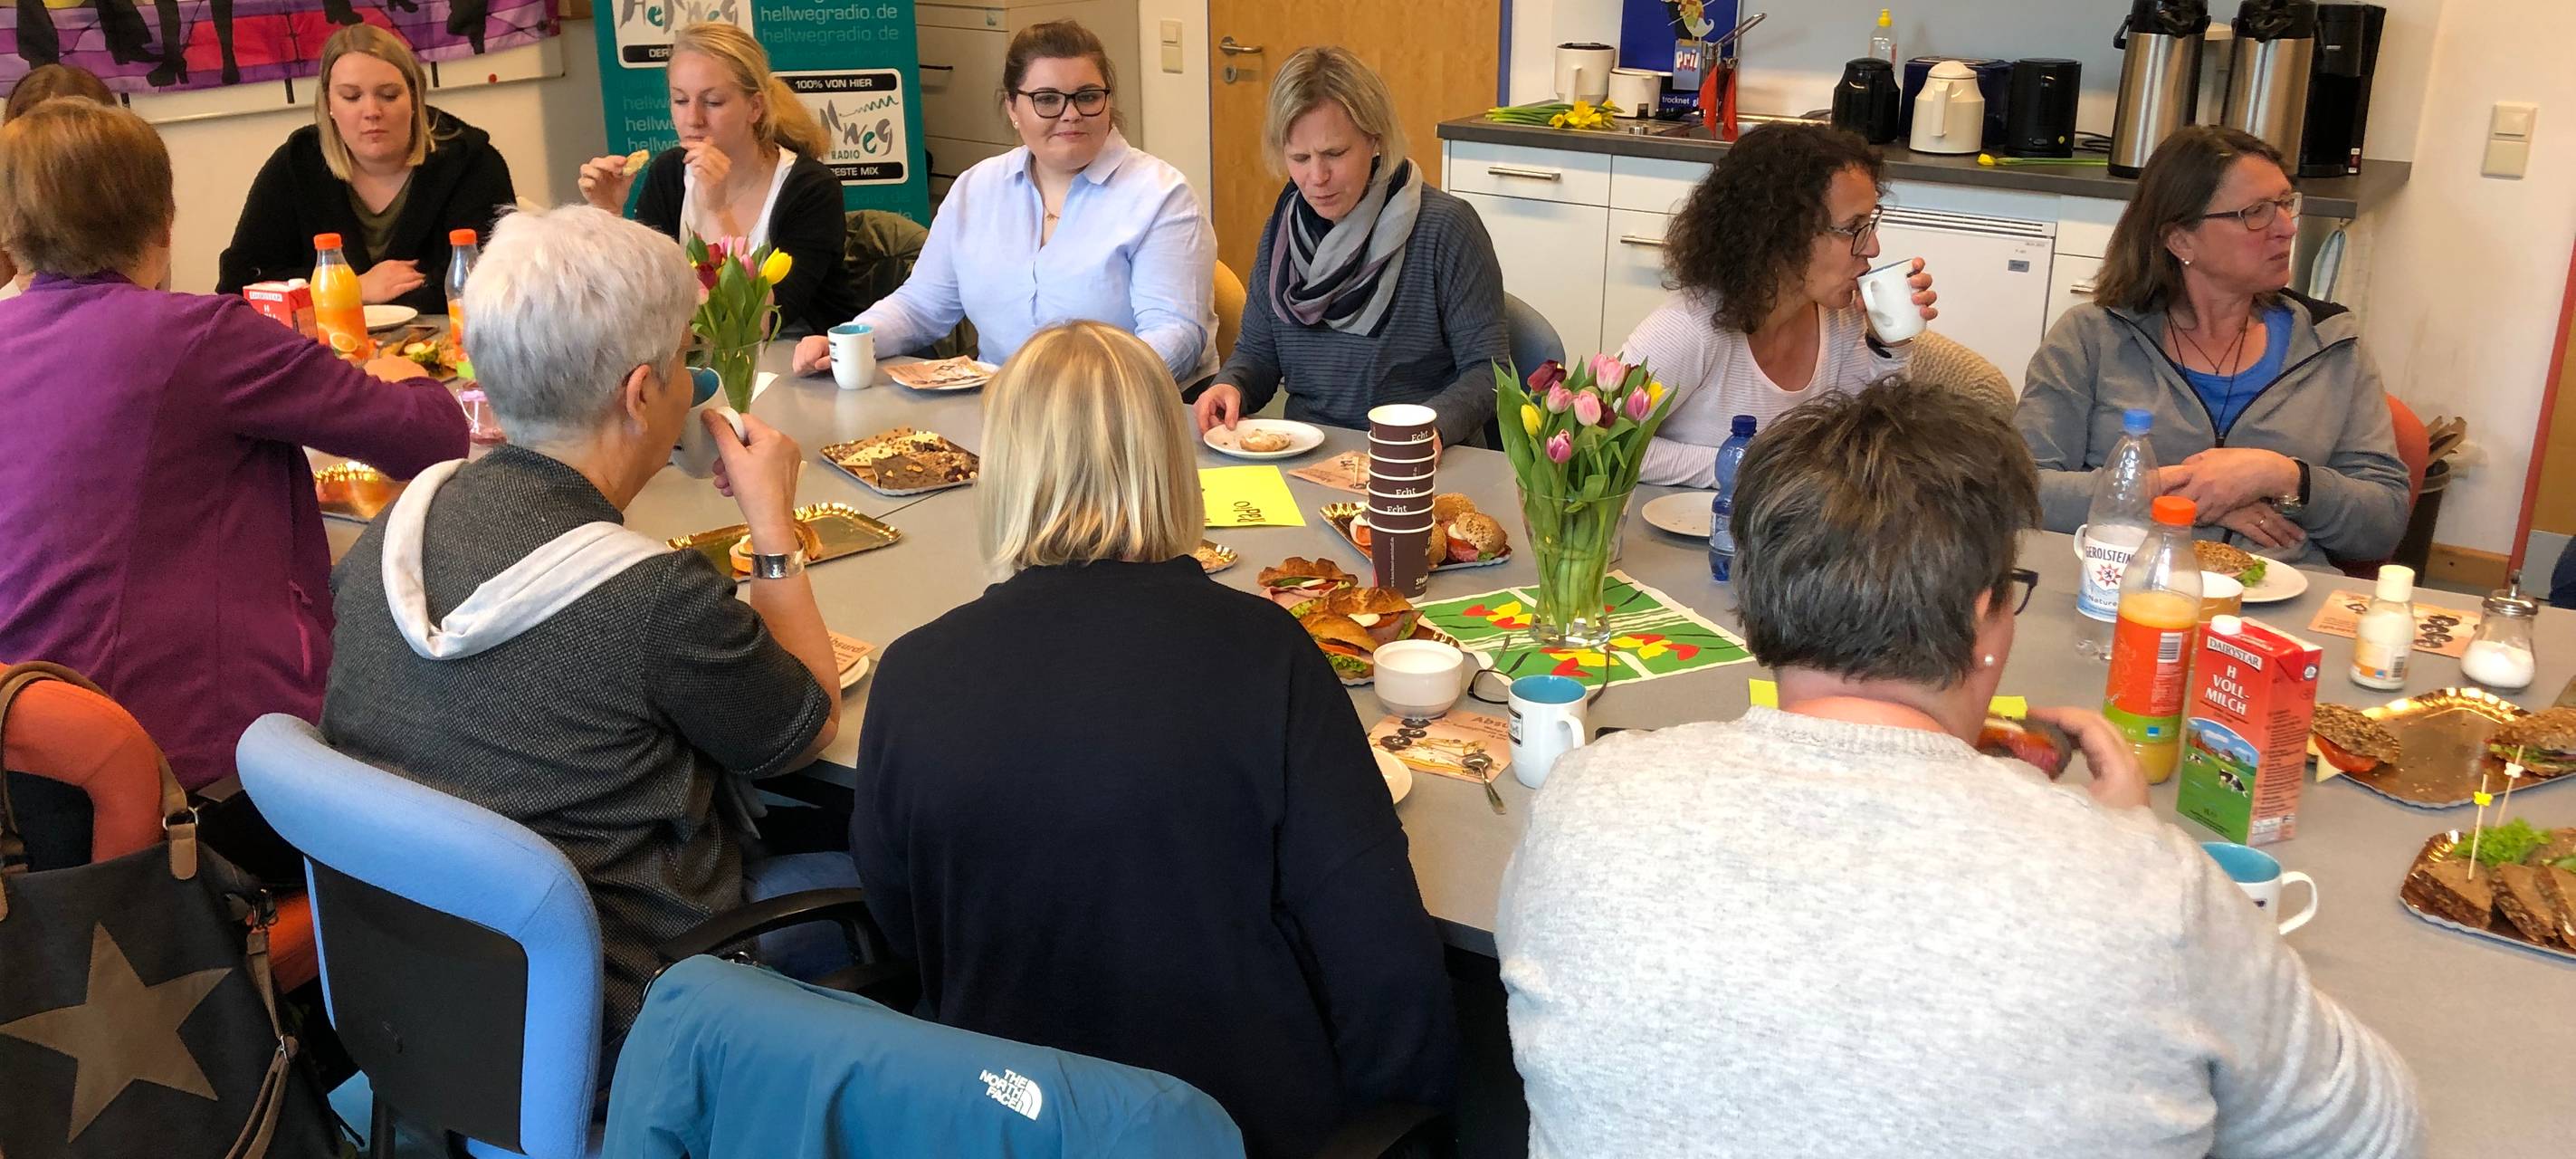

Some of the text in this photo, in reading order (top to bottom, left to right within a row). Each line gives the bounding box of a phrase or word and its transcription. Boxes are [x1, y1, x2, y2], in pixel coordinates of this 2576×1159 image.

[760, 4, 899, 25] hellwegradio.de
[1675, 49, 1700, 69] Pril
[795, 78, 873, 89] 100% VON HIER
[1662, 95, 1690, 104] trocknet
[831, 149, 861, 160] RADIO
[860, 167, 880, 176] MIX
[1411, 430, 1429, 442] Echt
[1396, 487, 1417, 496] Echt
[1387, 504, 1407, 513] Echt
[2208, 637, 2260, 667] DAIRYSTAR
[2227, 665, 2237, 679] H
[2213, 674, 2250, 700] VOLL-
[2204, 687, 2247, 715] MILCH
[978, 1069, 1026, 1101] NORTH
[1004, 1068, 1029, 1089] THE
[986, 1086, 1018, 1110] FACE
